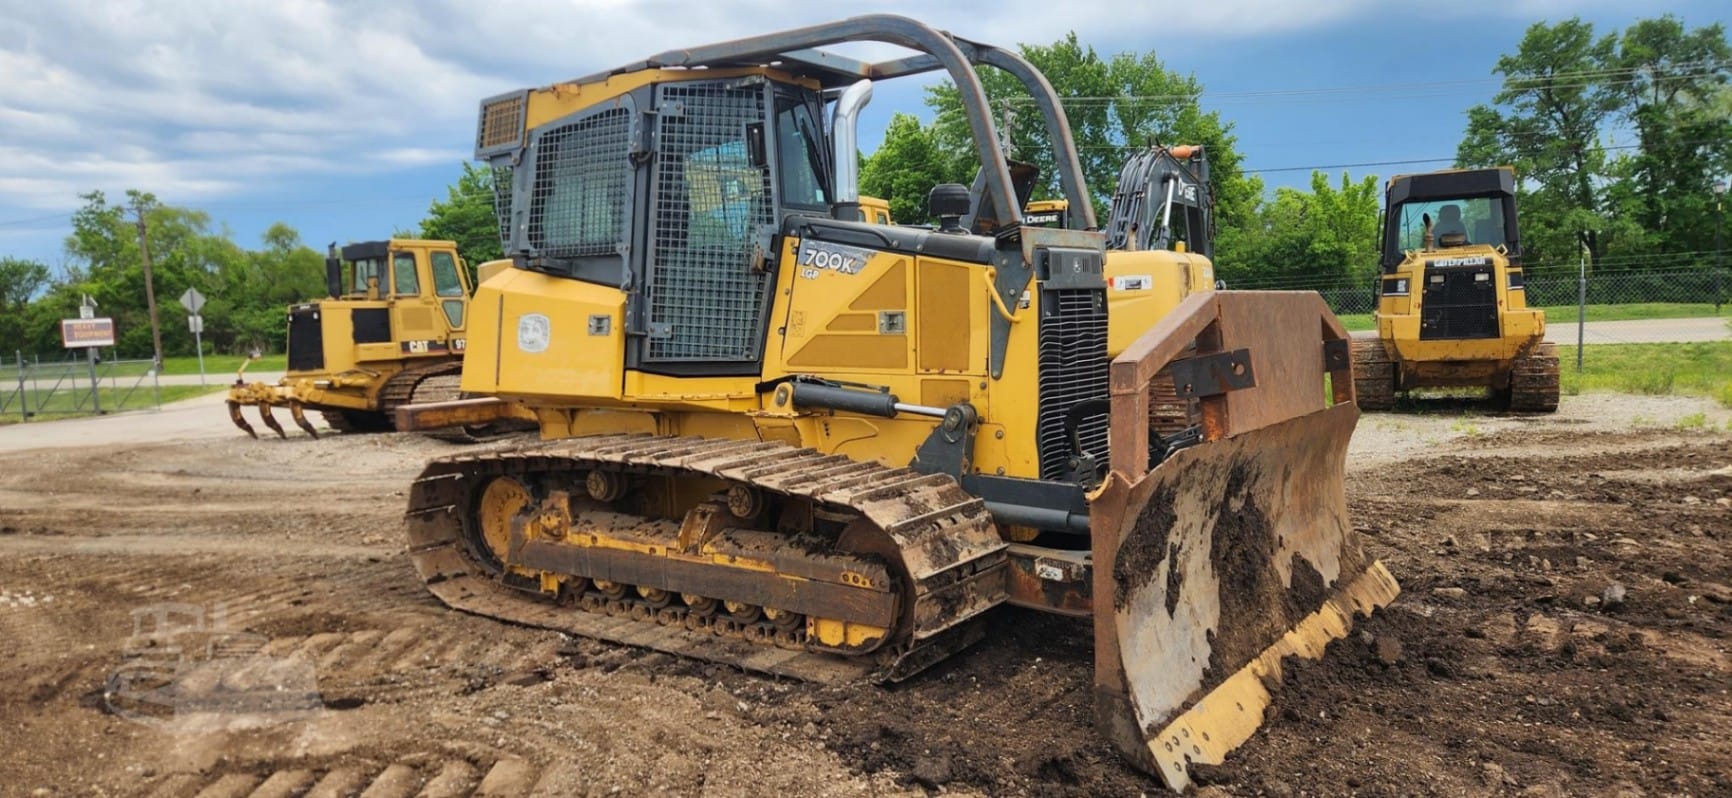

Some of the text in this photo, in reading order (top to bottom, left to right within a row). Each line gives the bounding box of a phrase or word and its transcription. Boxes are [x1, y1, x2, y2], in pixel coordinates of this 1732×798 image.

[1027, 215, 1058, 223] DEERE
[805, 249, 854, 273] 700K
[1434, 258, 1485, 267] CATERPILLAR
[801, 268, 819, 279] LGP
[409, 340, 428, 352] CAT
